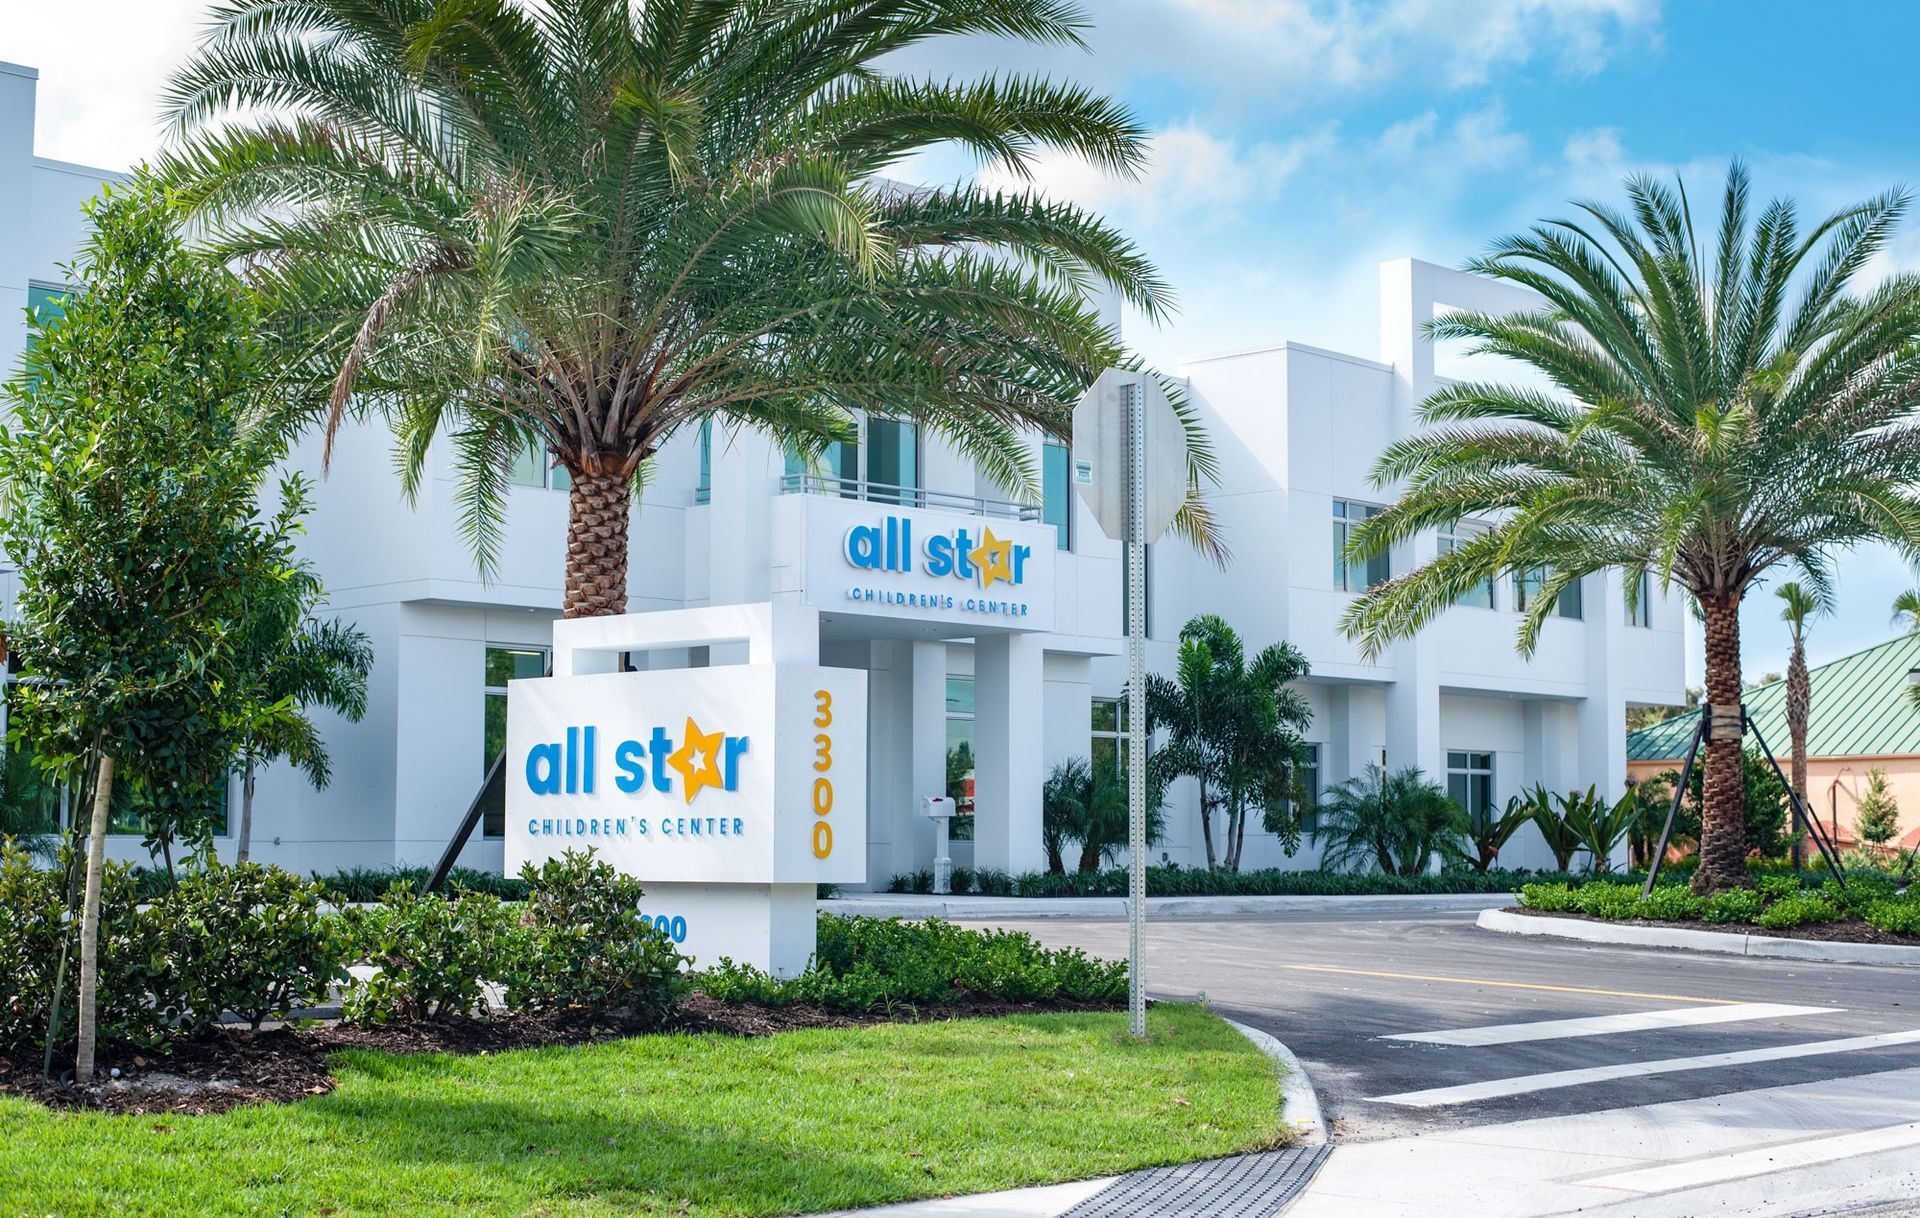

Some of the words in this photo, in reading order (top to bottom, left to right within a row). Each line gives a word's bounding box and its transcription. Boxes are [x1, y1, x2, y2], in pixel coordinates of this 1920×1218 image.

[848, 516, 911, 573] all
[852, 587, 953, 609] CHILDREN'S
[966, 598, 1028, 616] CENTER
[525, 725, 595, 795] all
[813, 690, 833, 859] 3300
[528, 815, 648, 836] CHILDREN'S
[661, 817, 744, 836] CENTER
